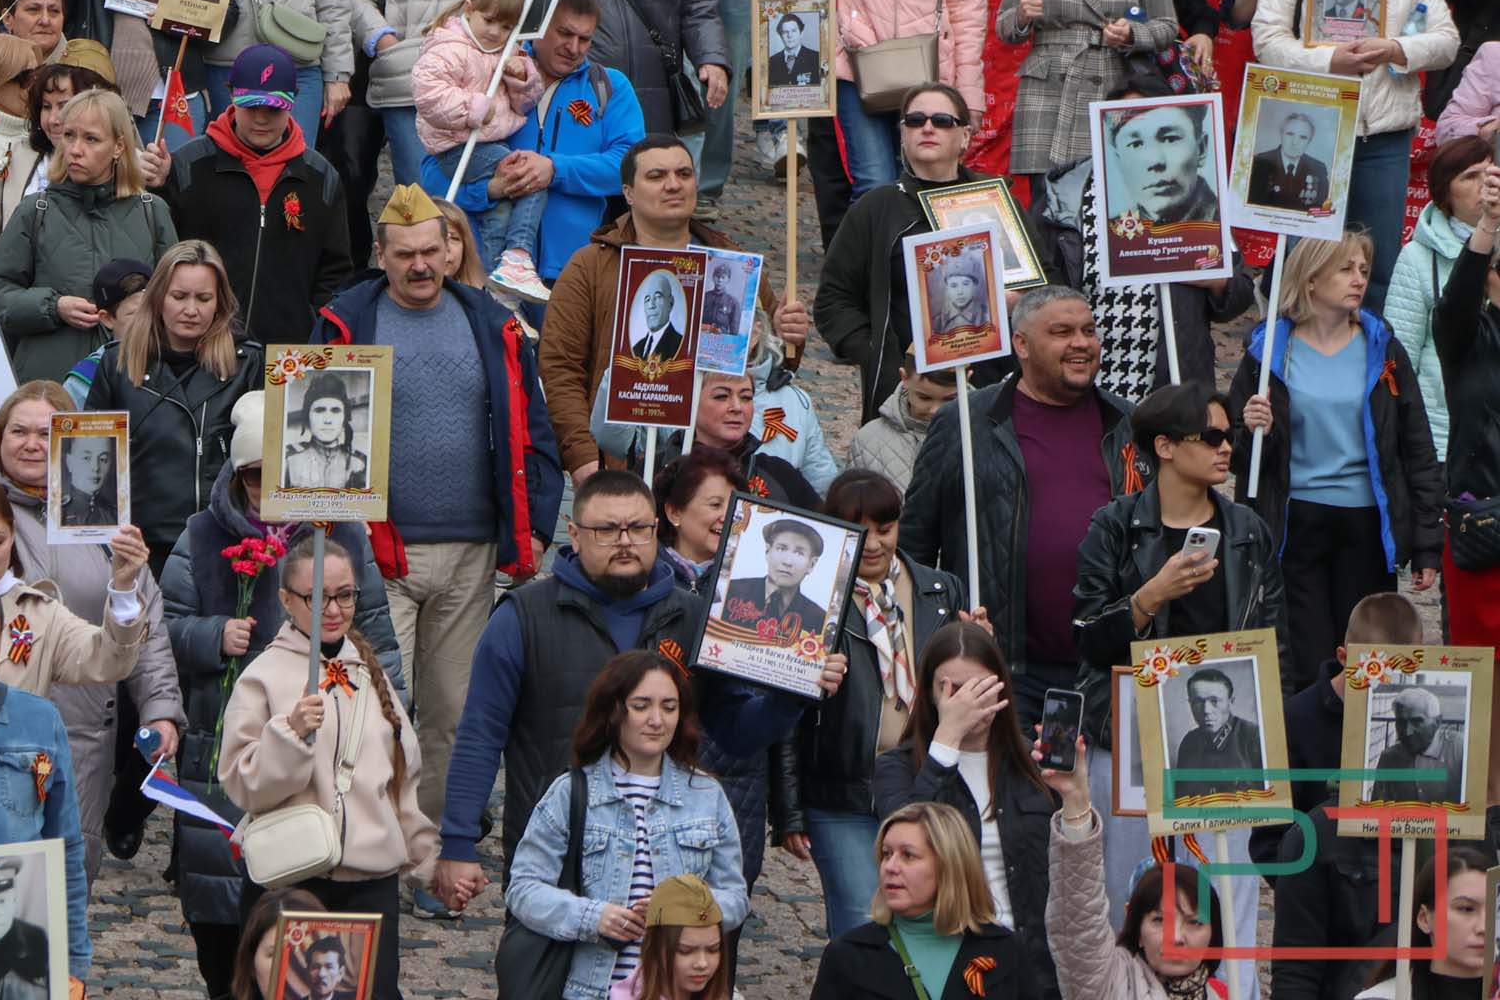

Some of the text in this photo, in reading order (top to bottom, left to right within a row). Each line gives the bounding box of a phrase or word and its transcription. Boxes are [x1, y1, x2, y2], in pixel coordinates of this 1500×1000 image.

[1148, 236, 1183, 246] Кушаков
[1119, 248, 1161, 259] Александр
[633, 382, 669, 392] АБДУЛЛИН
[618, 391, 683, 403] КАСЫМ КАРАМОВИЧ
[1172, 820, 1200, 832] Салих
